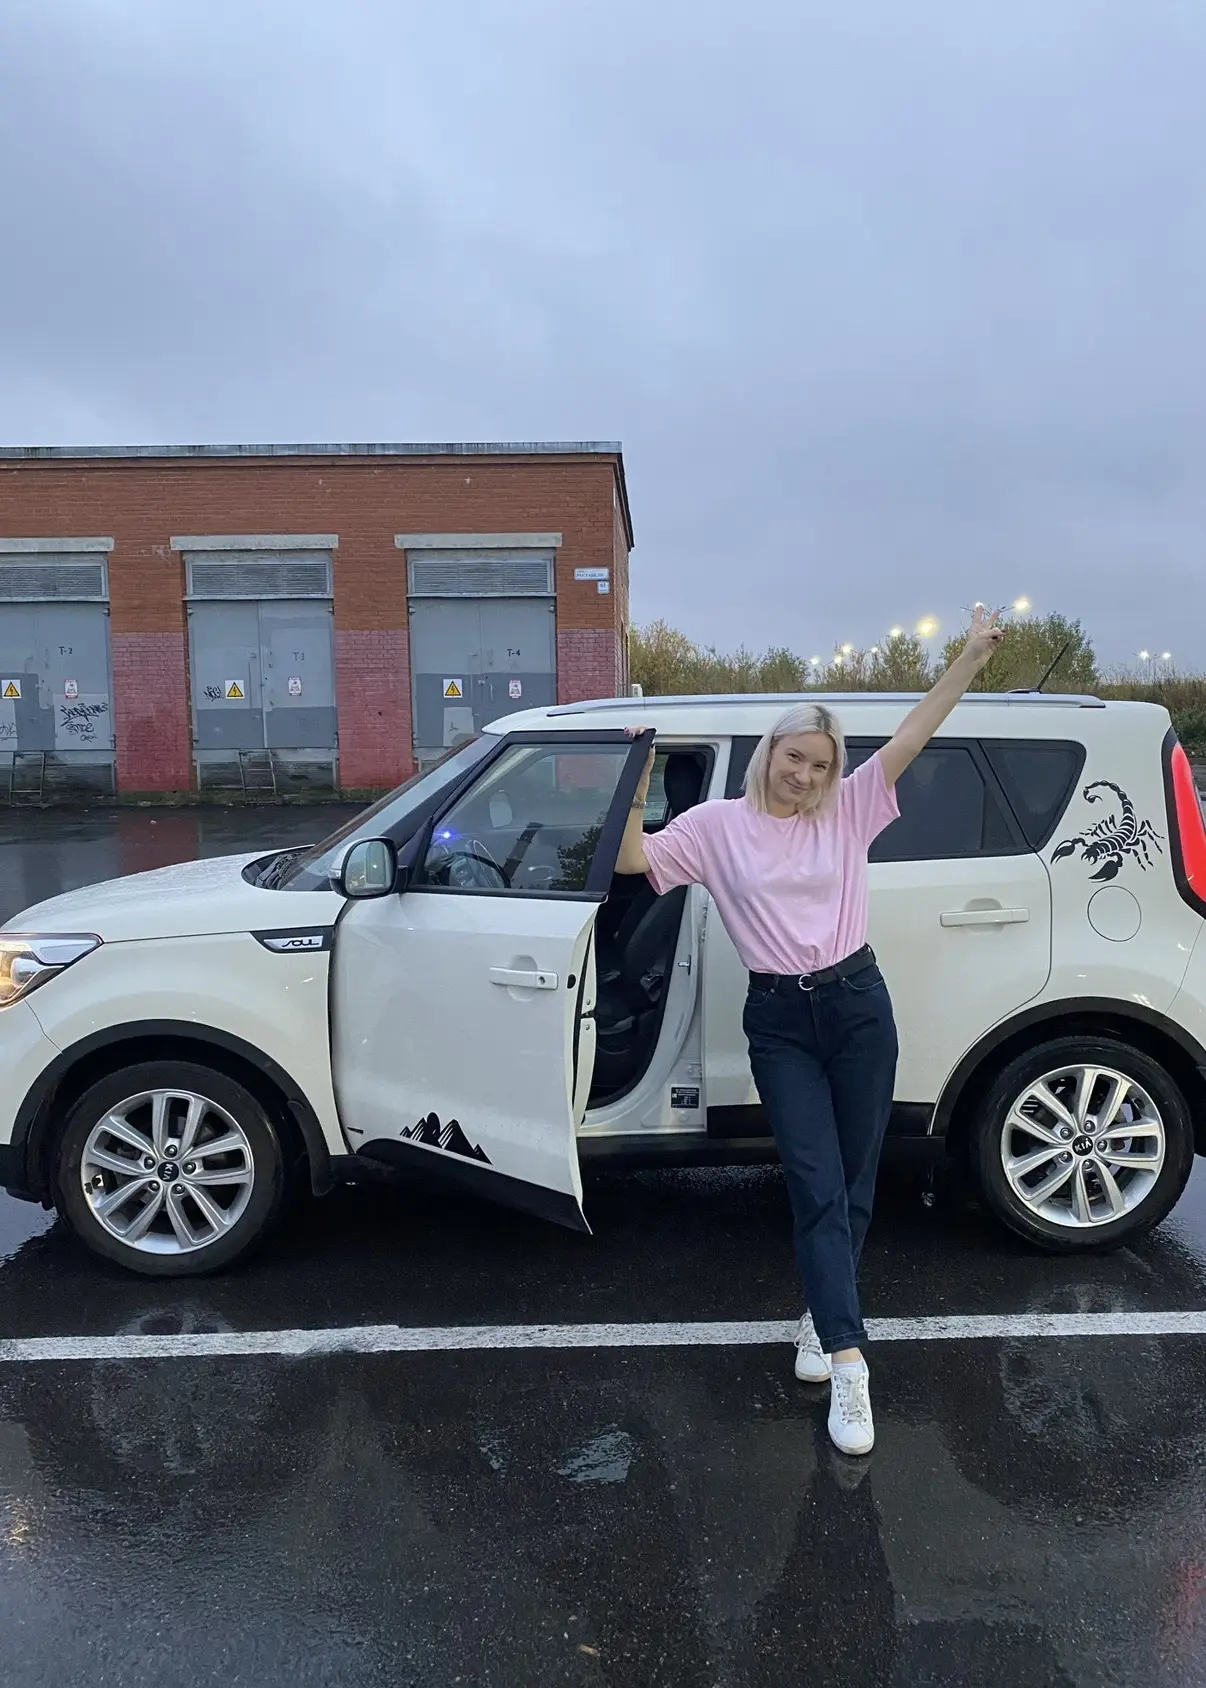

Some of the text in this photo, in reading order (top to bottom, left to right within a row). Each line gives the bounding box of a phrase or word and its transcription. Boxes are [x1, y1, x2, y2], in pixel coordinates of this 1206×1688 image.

[506, 648, 521, 657] Т-4
[282, 938, 319, 948] SOUL
[1074, 1138, 1092, 1153] KIA
[162, 1161, 173, 1181] KIA
